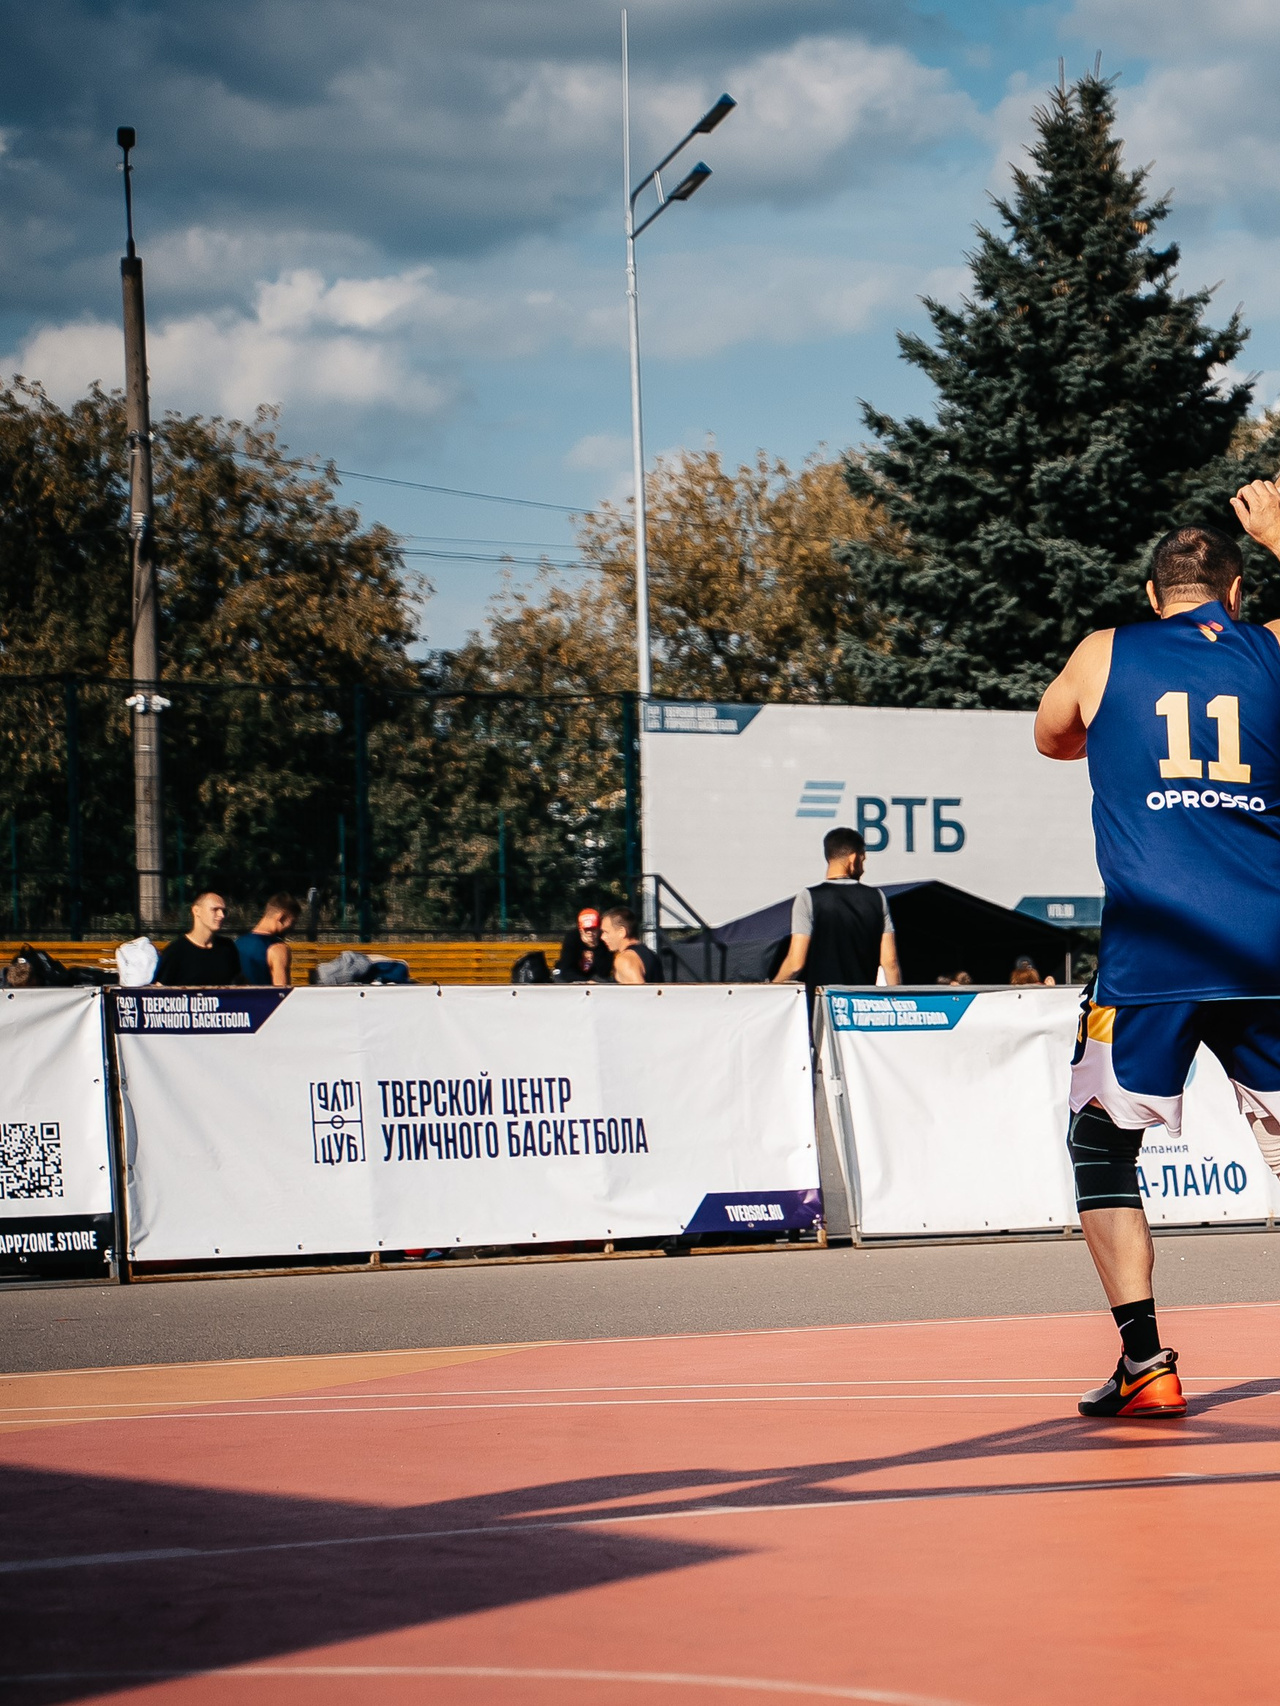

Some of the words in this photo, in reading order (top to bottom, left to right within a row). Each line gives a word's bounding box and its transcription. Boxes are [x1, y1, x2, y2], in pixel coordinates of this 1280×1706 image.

[1155, 691, 1251, 784] 11
[1146, 789, 1266, 812] OPROSSO
[856, 796, 966, 853] ВТБ
[142, 994, 189, 1013] ТВЕРСКОЙ
[190, 996, 219, 1013] ЦЕНТР
[143, 1013, 190, 1028] УЛИЧНОГО
[192, 1012, 251, 1028] БАСКЕТБОЛА
[378, 1071, 494, 1117] ТВЕРСКОЙ
[502, 1077, 572, 1117] ЦЕНТР
[321, 1133, 358, 1165] ЦУБ
[381, 1121, 499, 1162] УЛИЧНОГО
[507, 1117, 649, 1157] БАСКЕТБОЛА
[1141, 1144, 1189, 1154] мпания
[1136, 1156, 1247, 1198] А-ЛАЙФ
